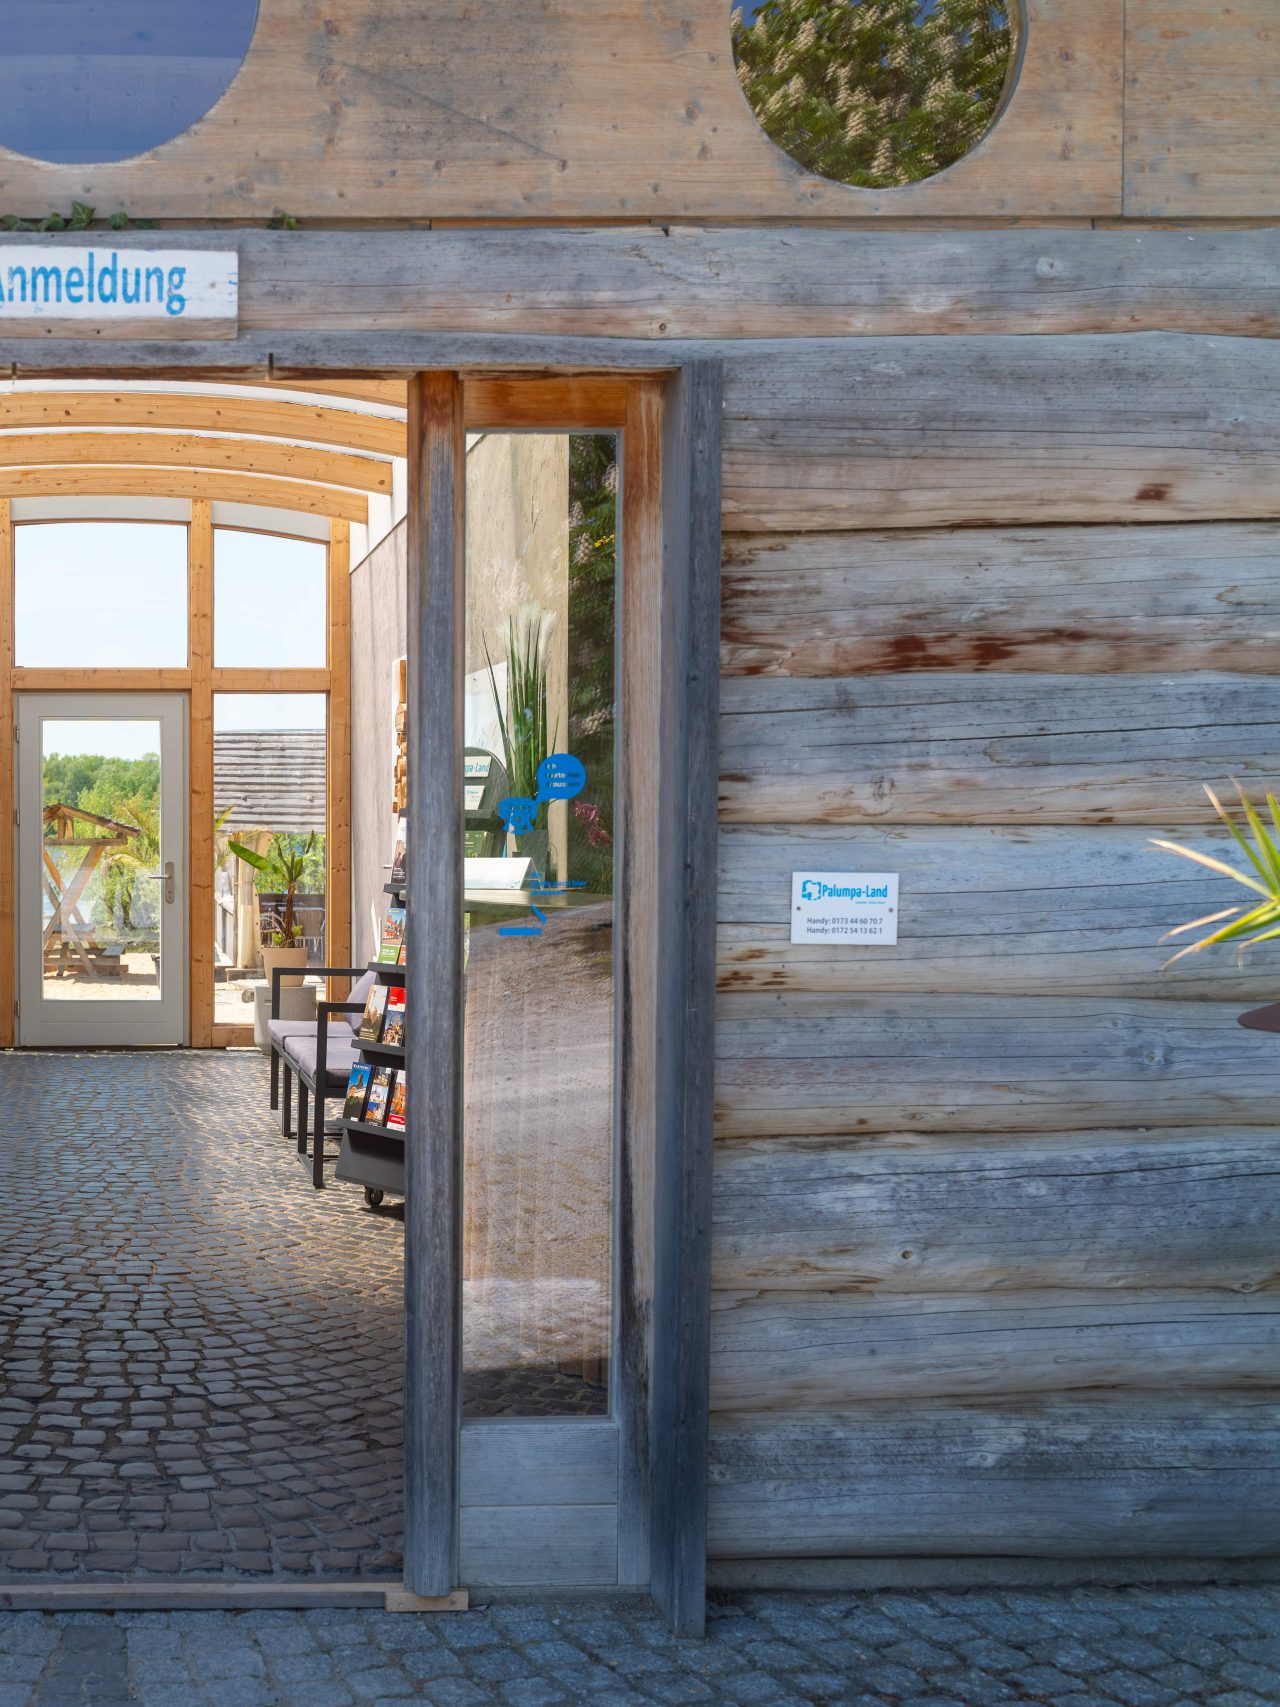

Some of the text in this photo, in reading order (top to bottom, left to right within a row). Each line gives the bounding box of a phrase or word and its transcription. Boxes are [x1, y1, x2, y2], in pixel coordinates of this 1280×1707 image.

[822, 884, 888, 900] Palumpa-Land
[806, 917, 831, 925] Handy:
[832, 917, 848, 925] 0173
[806, 927, 831, 935] Handy:
